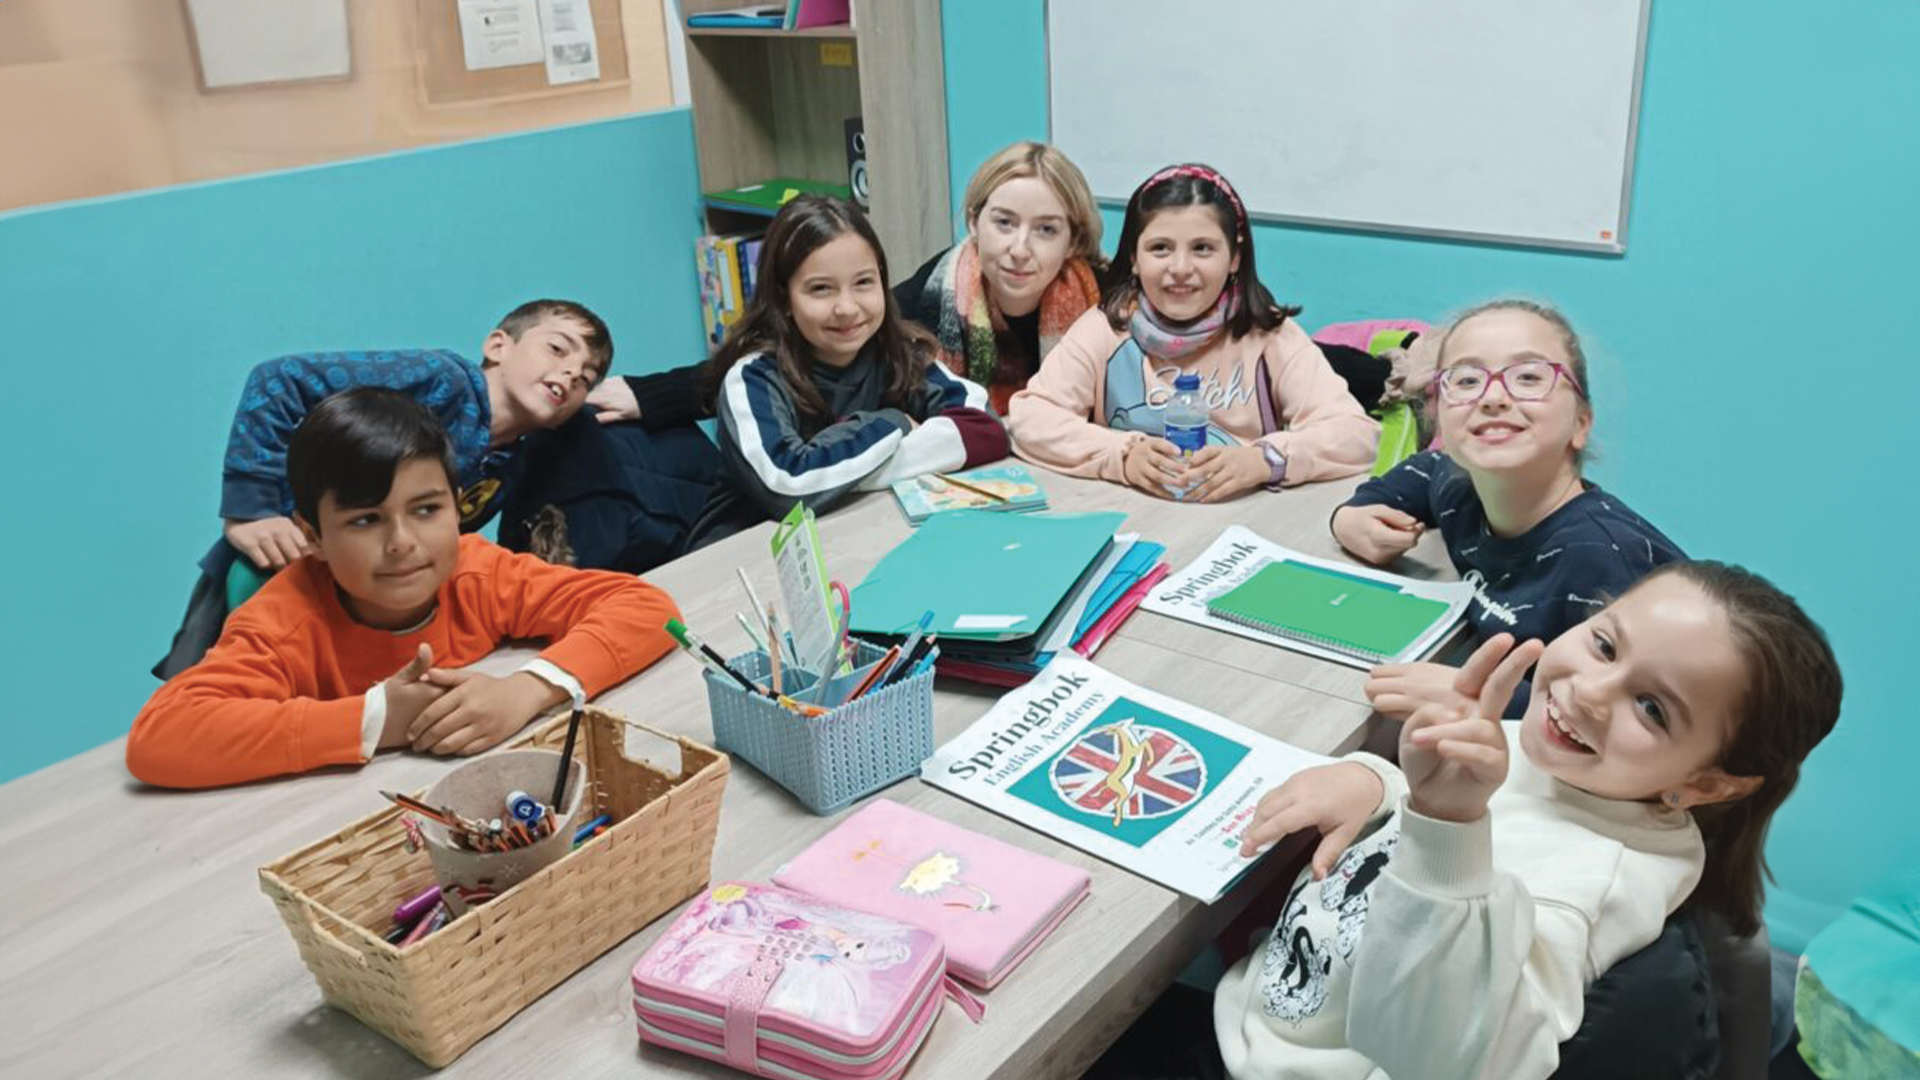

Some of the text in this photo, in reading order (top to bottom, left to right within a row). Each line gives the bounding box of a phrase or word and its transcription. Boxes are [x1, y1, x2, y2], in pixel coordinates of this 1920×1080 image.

[1147, 362, 1256, 410] Stch
[1159, 542, 1258, 606] Springbok
[948, 671, 1090, 780] Springbok
[983, 690, 1106, 786] English Academy
